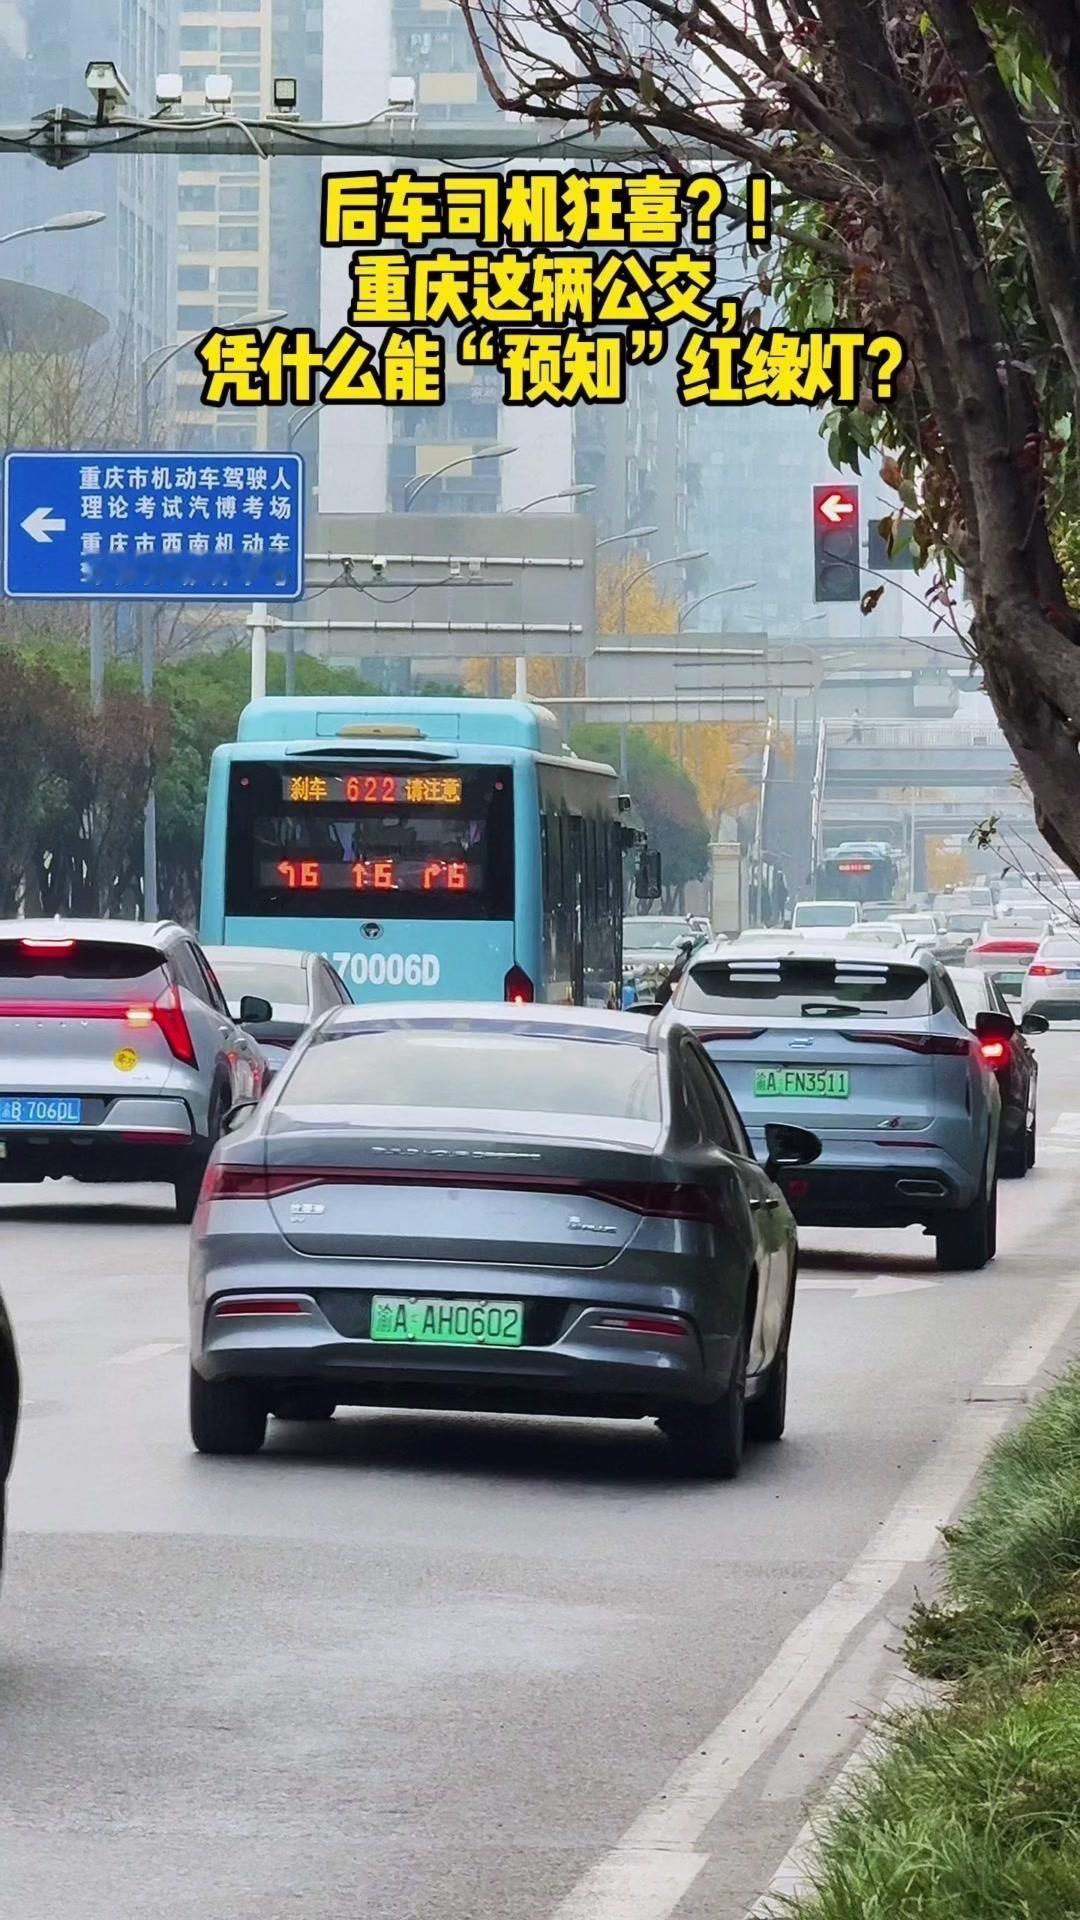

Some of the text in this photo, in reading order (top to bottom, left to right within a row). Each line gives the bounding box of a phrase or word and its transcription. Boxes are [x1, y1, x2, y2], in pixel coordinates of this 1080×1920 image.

[79, 465, 292, 490] 重庆市机动车驾驶人
[80, 495, 292, 520] 理论考试汽博考场
[80, 531, 290, 554] 重庆市西南机动车
[290, 776, 461, 802] 刹车 622 请注意
[320, 951, 440, 986] 70006D
